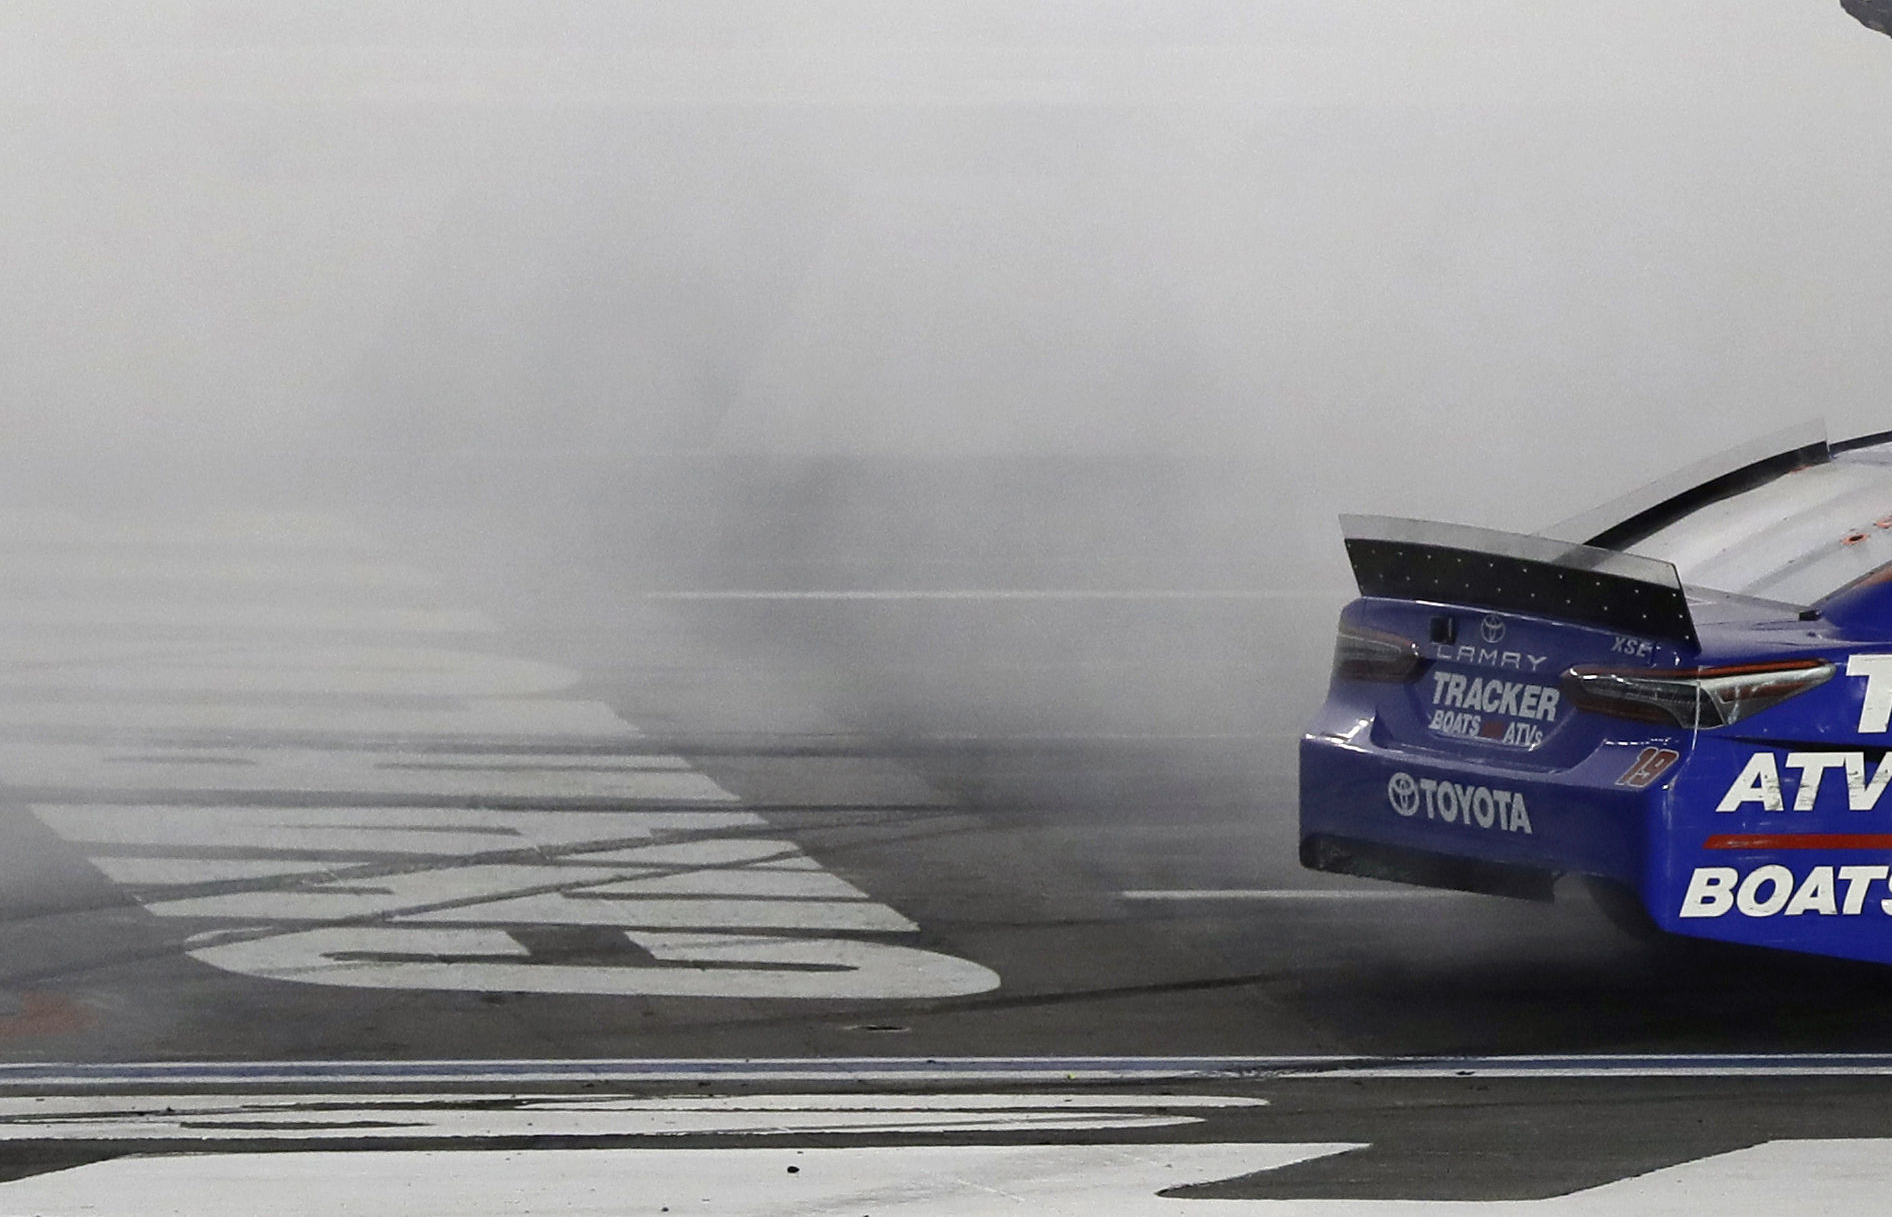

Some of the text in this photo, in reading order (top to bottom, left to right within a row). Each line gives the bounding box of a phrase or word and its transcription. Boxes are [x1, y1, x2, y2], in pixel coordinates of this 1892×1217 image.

[1432, 671, 1560, 721] TRACKER
[1428, 709, 1543, 746] BOATS ATVs
[1614, 747, 1680, 788] 19
[1420, 778, 1533, 834] TOYOTA
